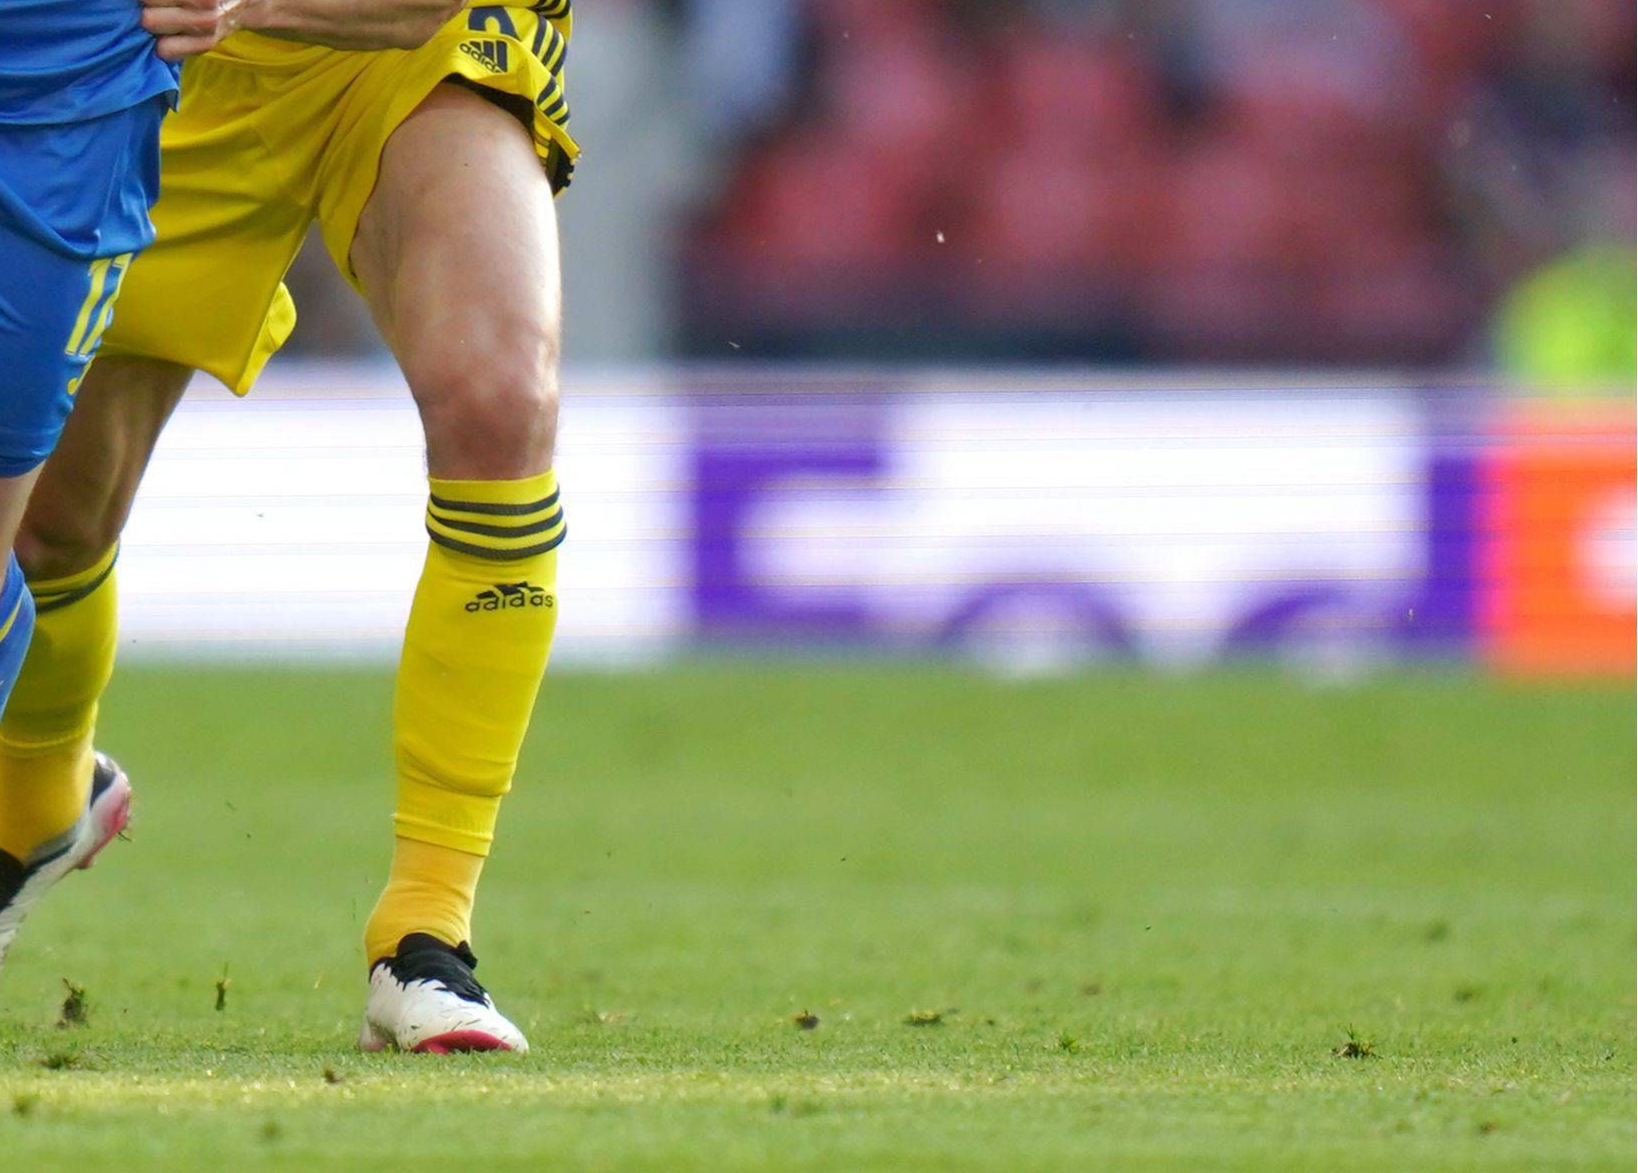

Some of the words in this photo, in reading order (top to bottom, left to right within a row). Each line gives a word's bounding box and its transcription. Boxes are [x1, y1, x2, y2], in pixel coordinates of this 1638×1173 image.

[459, 42, 503, 74] adid
[65, 252, 133, 356] 17
[465, 590, 553, 612] adidas
